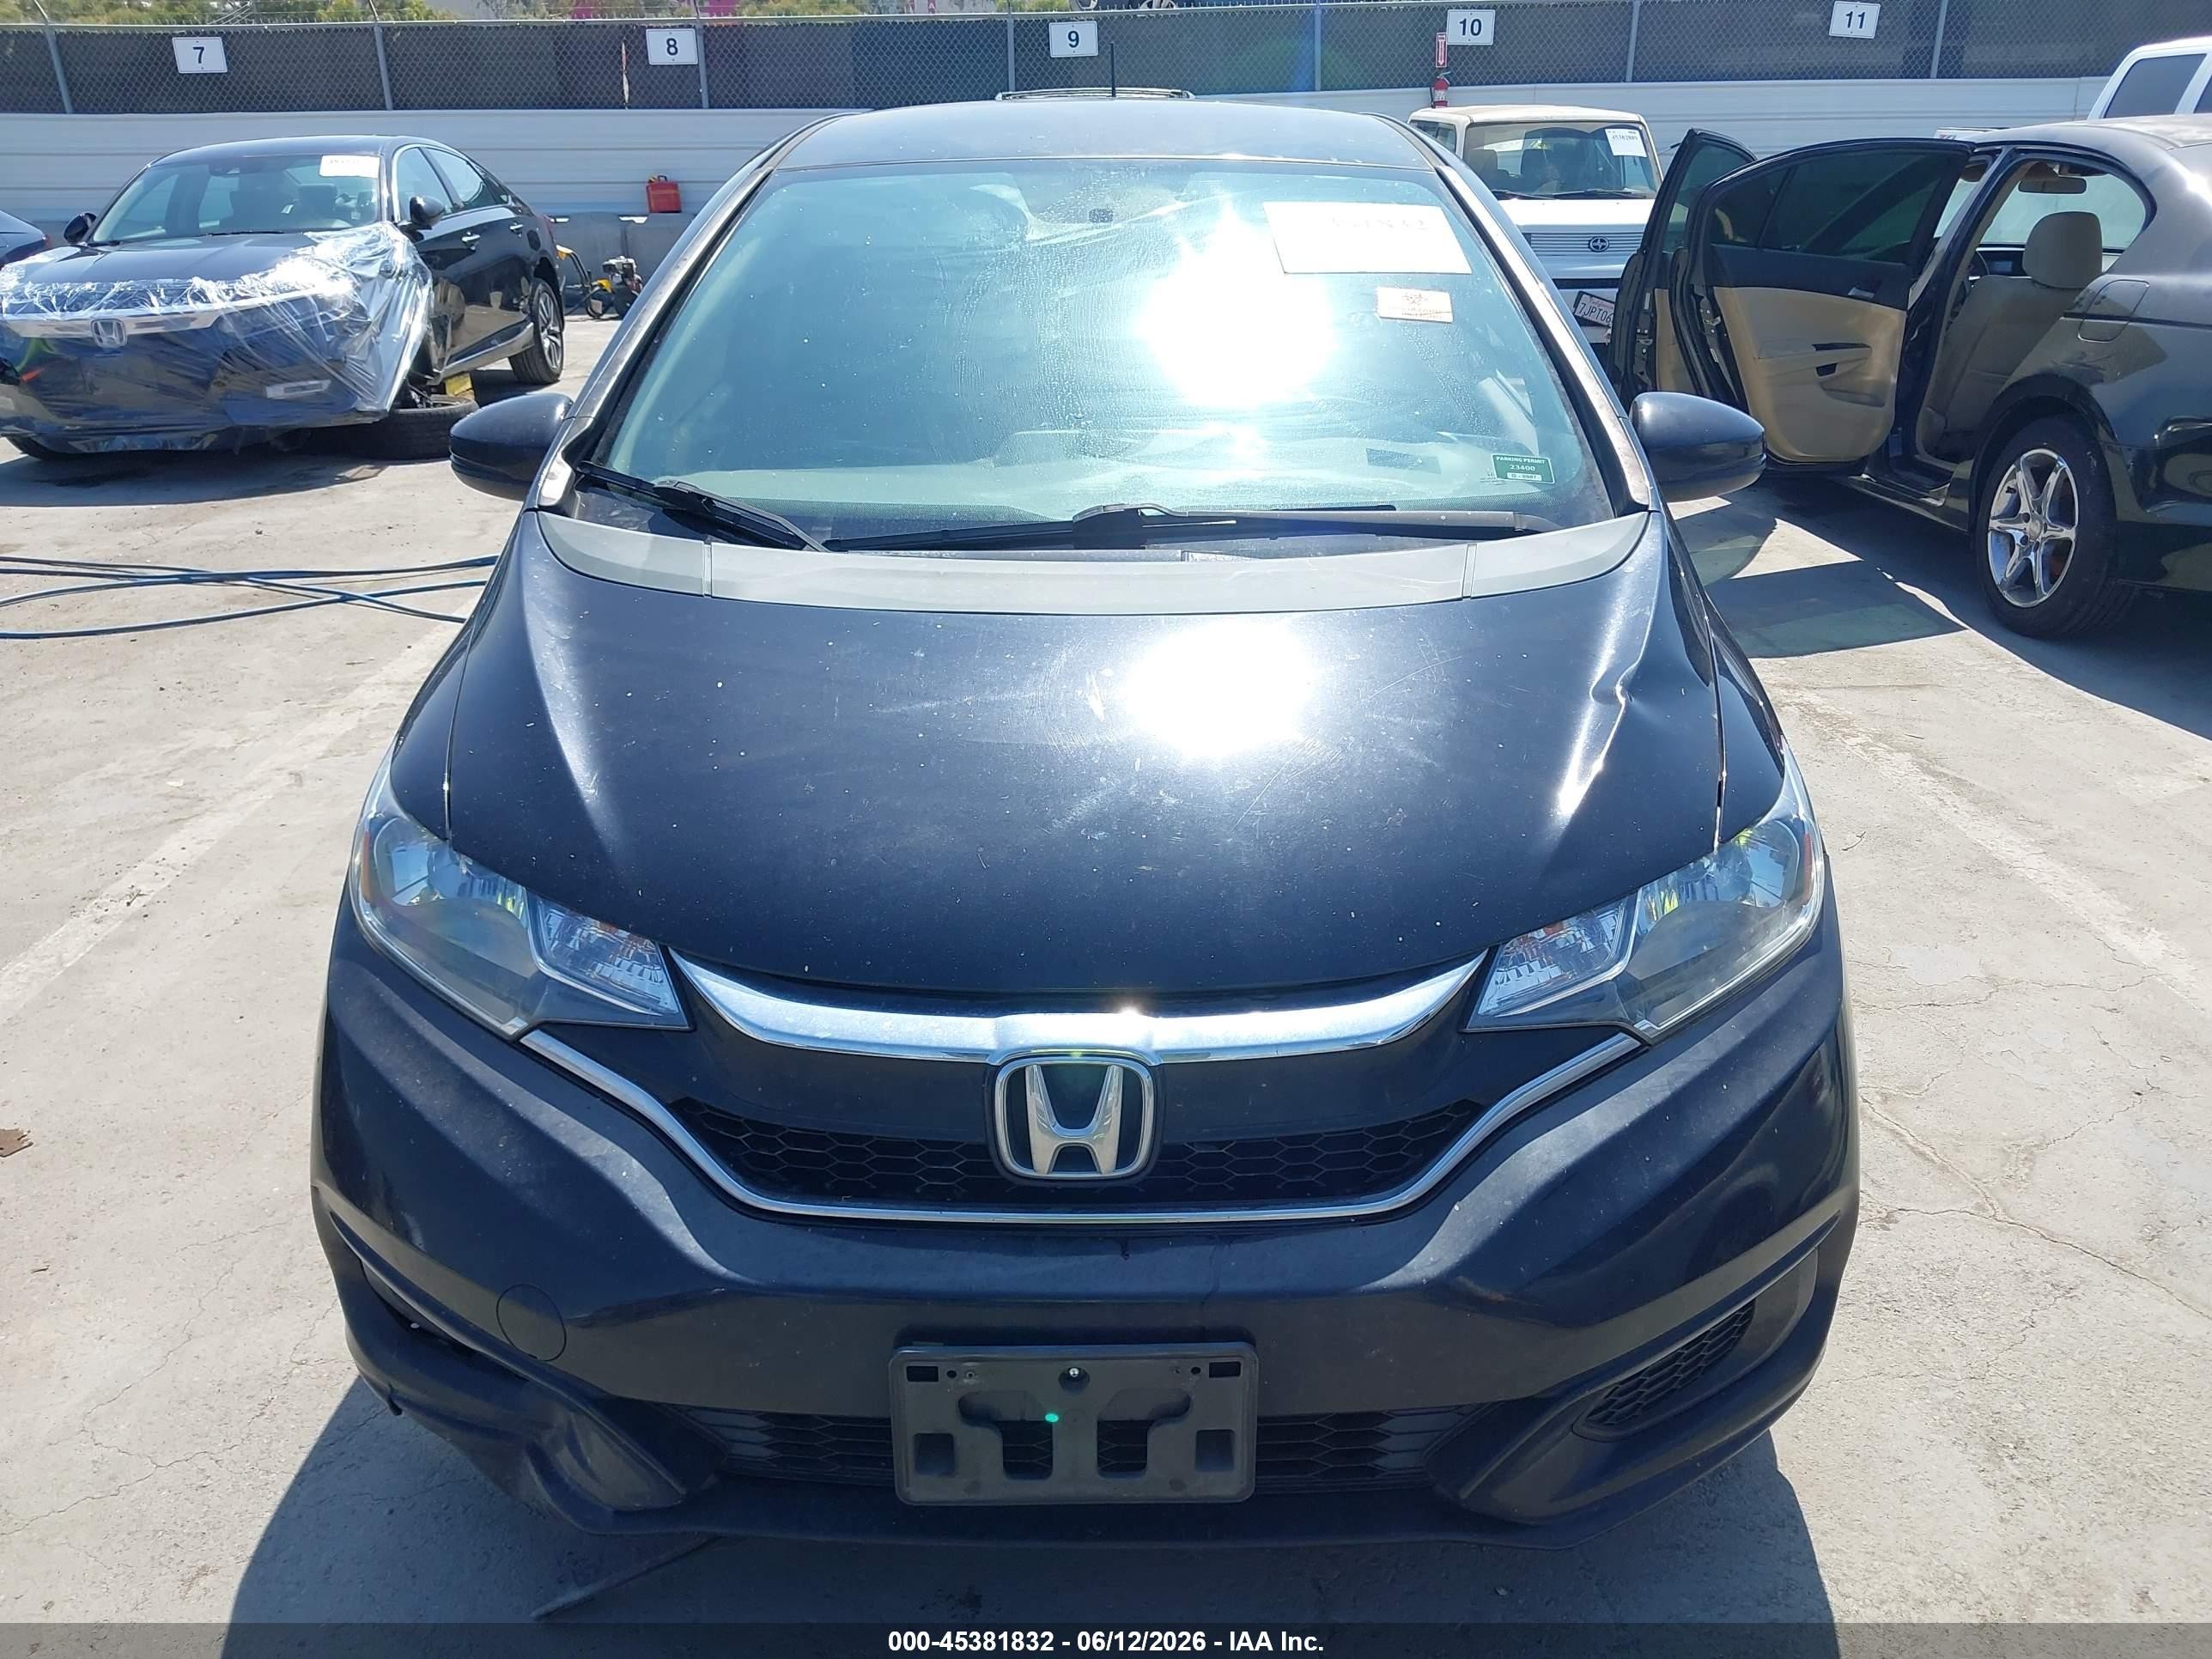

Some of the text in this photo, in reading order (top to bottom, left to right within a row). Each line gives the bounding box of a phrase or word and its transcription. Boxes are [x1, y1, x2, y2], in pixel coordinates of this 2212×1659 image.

[1459, 18, 1482, 36] 10
[1845, 10, 1866, 29] 11
[666, 38, 678, 56] 8
[1067, 30, 1079, 48] 9
[192, 46, 205, 64] 7
[1579, 302, 1614, 324] 7JPT06
